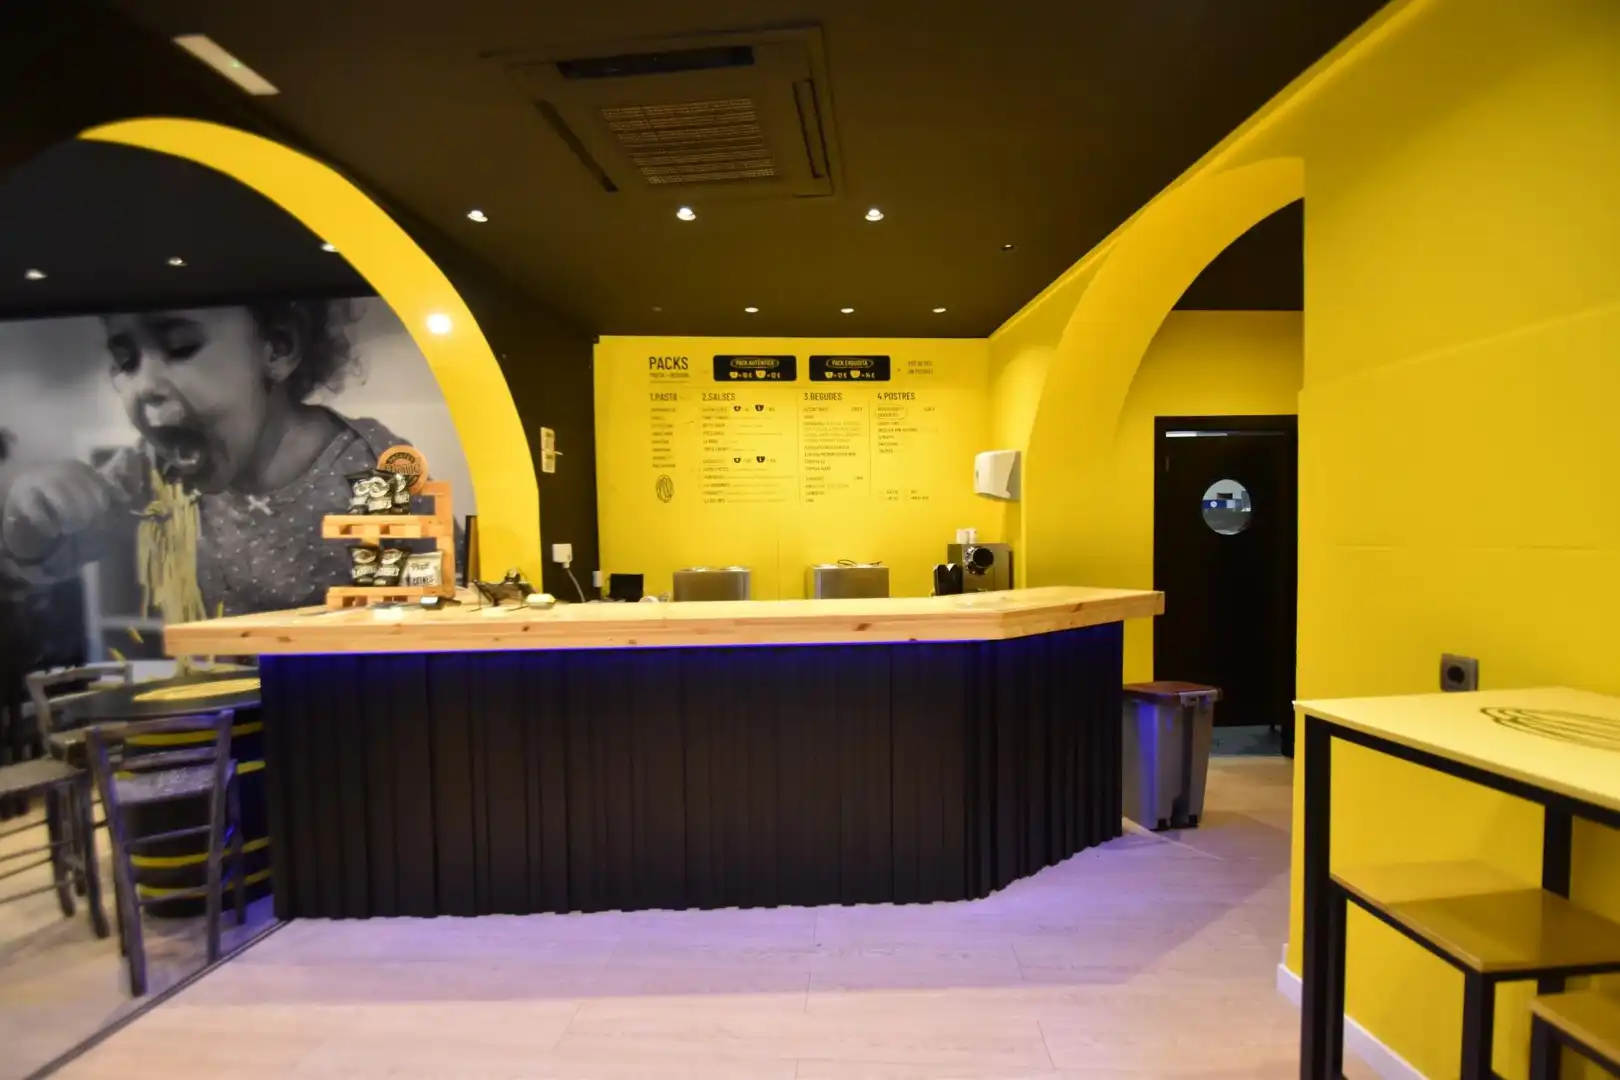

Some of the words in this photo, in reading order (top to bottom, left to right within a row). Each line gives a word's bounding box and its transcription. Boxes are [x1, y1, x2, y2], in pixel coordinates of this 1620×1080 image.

[648, 356, 689, 370] PACKS
[649, 392, 678, 401] 1.PASTA
[701, 392, 736, 401] 2.SALSES
